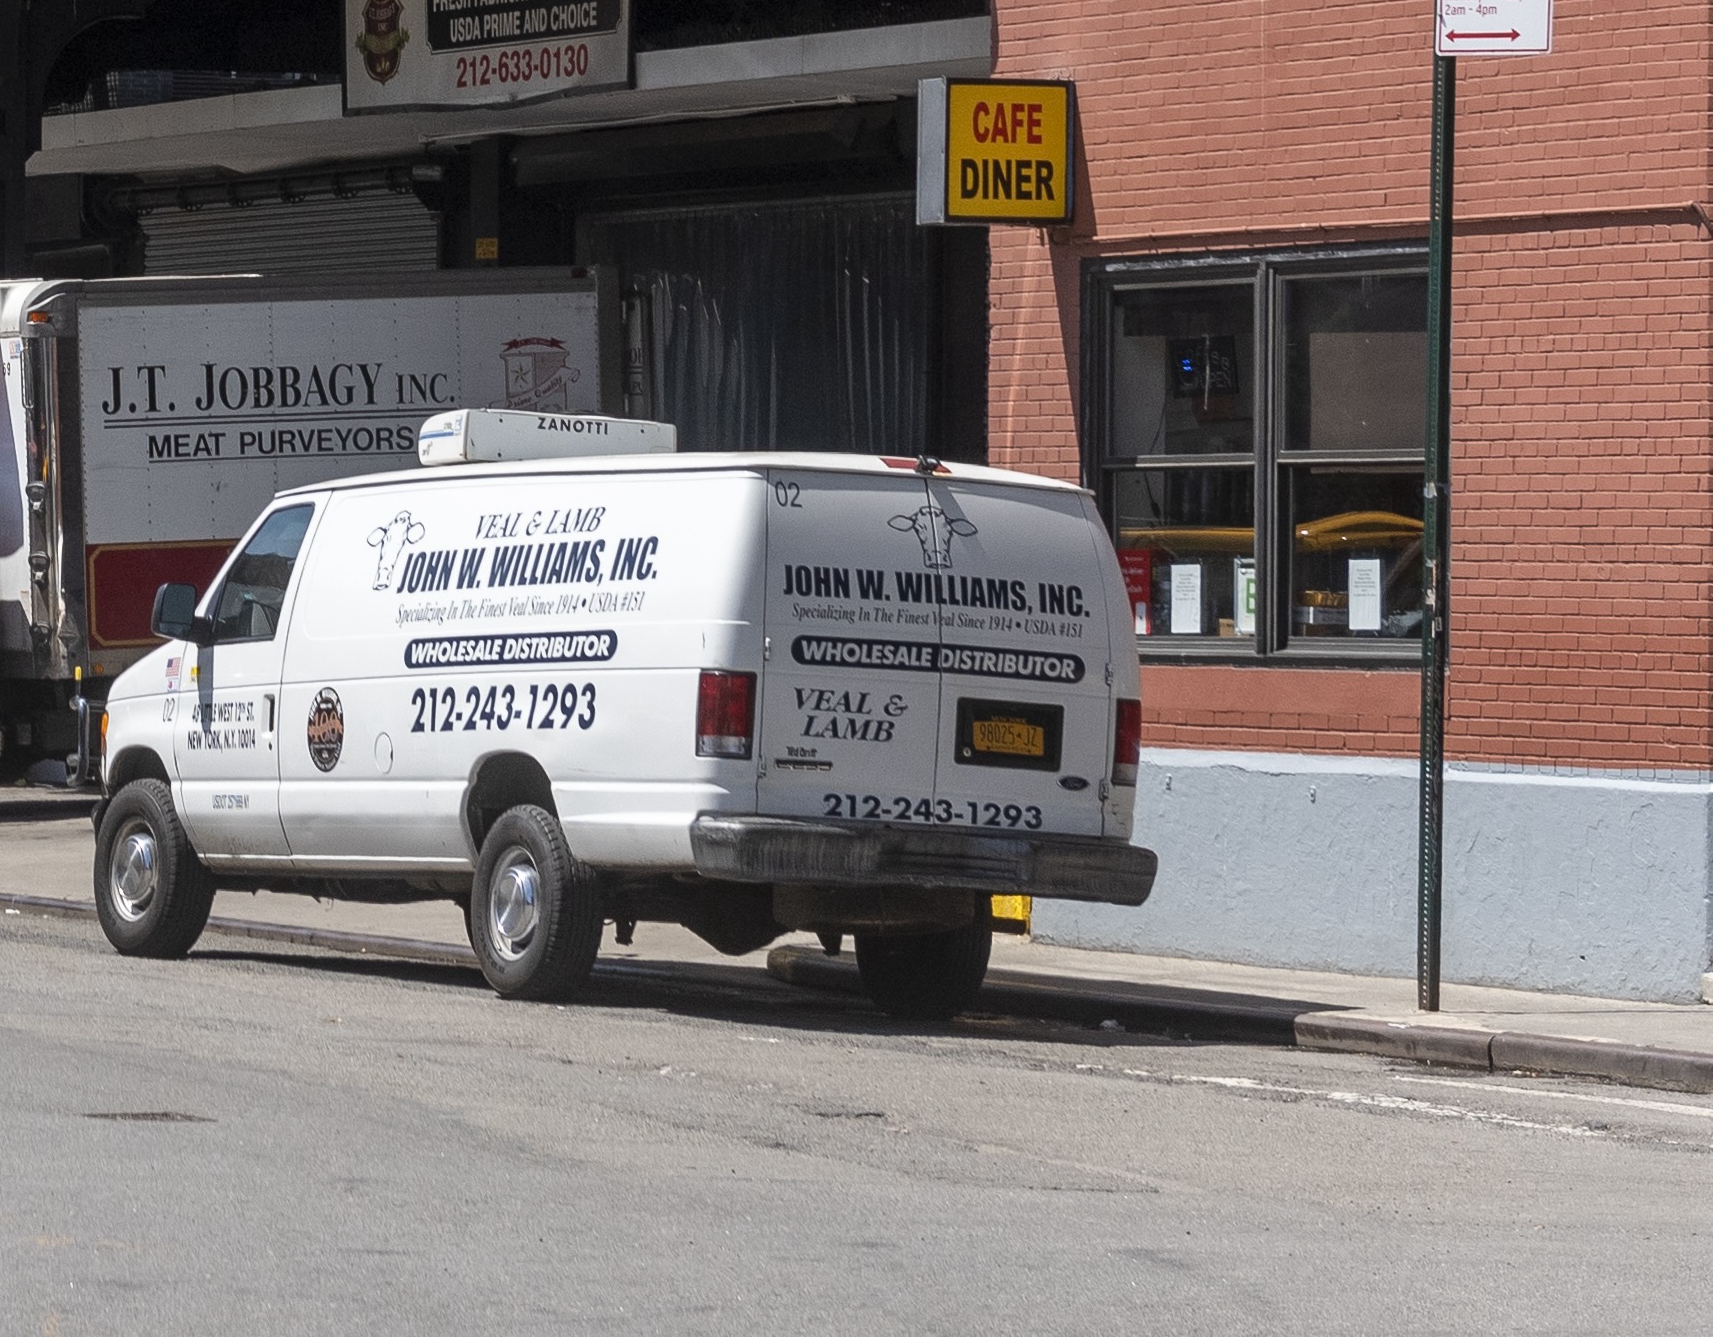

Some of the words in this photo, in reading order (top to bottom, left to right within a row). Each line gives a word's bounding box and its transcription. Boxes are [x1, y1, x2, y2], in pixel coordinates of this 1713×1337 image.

[450, 17, 481, 44] USDA
[484, 12, 521, 39] PRIME
[523, 9, 548, 35] AND
[550, 2, 598, 30] CHOICE
[1445, 4, 1466, 16] 2am
[1476, 4, 1498, 17] 4pm
[456, 43, 589, 89] 212-633-0130
[972, 101, 1043, 145] CAFE
[960, 158, 1055, 201] DINER
[101, 365, 176, 415] J.T.
[195, 362, 383, 412] JOBBAGY
[396, 372, 455, 405] INC.
[148, 432, 226, 459] MEAT
[239, 426, 414, 456] PURVEYORS
[537, 416, 609, 436] ZANOTTI
[774, 480, 803, 509] 02
[474, 512, 523, 540] VEAL
[527, 511, 542, 536] &
[543, 506, 607, 534] LAMB
[396, 546, 459, 594] JOHN
[456, 547, 485, 590] W.
[487, 538, 606, 587] WILLIAMS,
[608, 535, 660, 582] INC.
[783, 563, 851, 600] JOHN
[856, 568, 891, 602] W.
[895, 570, 1034, 616] WILLIAMS,
[1038, 581, 1091, 618] INC.
[395, 598, 446, 628] Specializing
[447, 601, 459, 620] In
[459, 600, 478, 620] The
[479, 597, 507, 618] Finest
[507, 597, 528, 617] Veal
[530, 594, 555, 615] Since
[556, 593, 580, 613] 1914
[588, 592, 620, 612] USDA
[620, 591, 646, 611] #151
[791, 602, 855, 624] Specializing
[858, 606, 871, 622] In
[874, 607, 894, 623] The
[896, 608, 930, 626] Finest
[932, 610, 956, 627] Veal
[957, 612, 985, 630] Since
[988, 615, 1013, 631] 1914
[1024, 619, 1057, 637] USDA
[1059, 622, 1083, 638] #151
[410, 639, 501, 664] WHOLESALE
[502, 633, 611, 660] DISTRIBUTOR
[801, 639, 933, 668] WHOLESALE
[937, 649, 1076, 679] DISTRIBUTOR
[162, 697, 176, 723] 02
[217, 702, 234, 722] WEST
[410, 681, 597, 733] 212-243-1293
[794, 686, 872, 716] VEAL
[883, 694, 909, 717] &
[188, 730, 204, 750] NEW
[204, 731, 223, 754] YORK,
[237, 729, 256, 749] 10014
[800, 713, 896, 743] LAMB
[823, 792, 1043, 829] 212-243-1293
